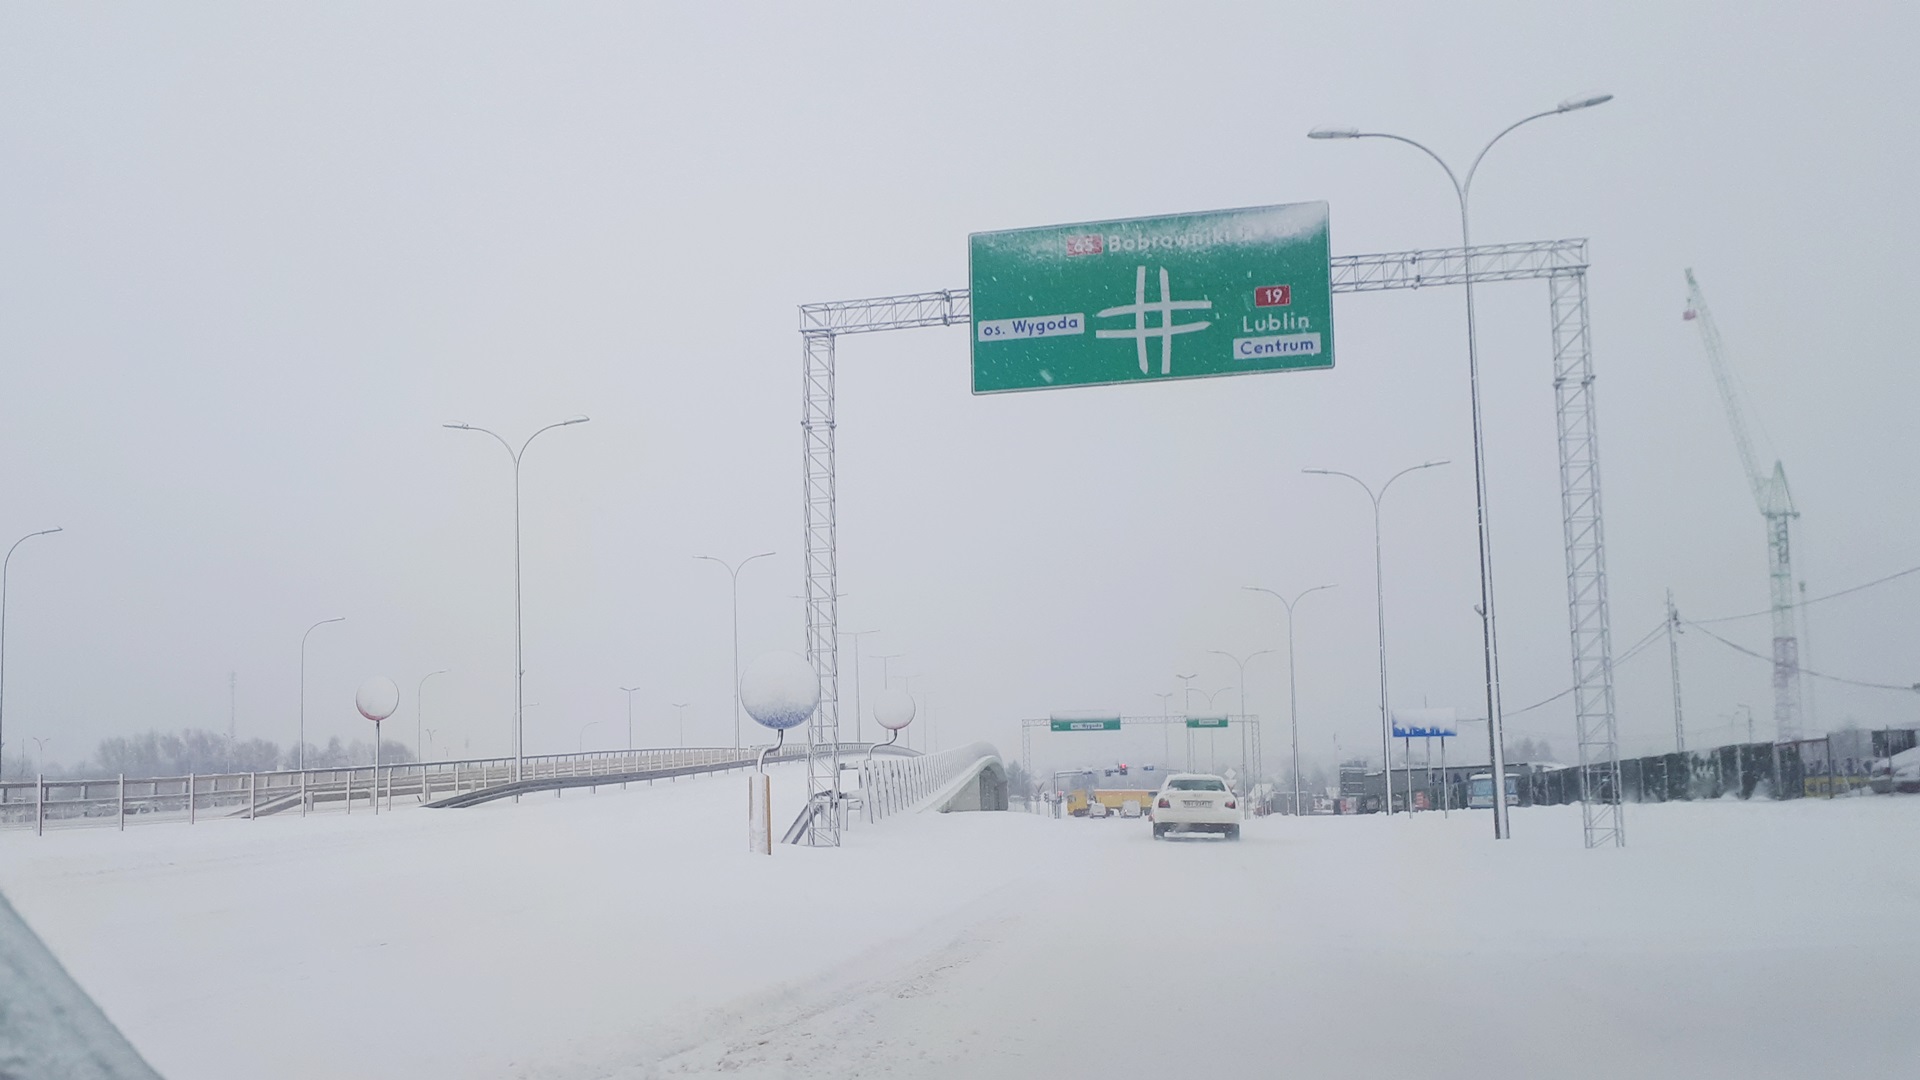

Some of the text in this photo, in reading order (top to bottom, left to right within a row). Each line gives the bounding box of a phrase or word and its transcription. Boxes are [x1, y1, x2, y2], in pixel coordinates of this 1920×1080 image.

[1072, 232, 1231, 253] 65 Bobrowniki
[1265, 288, 1283, 303] 19
[983, 316, 1078, 337] os. Wygoda
[1243, 314, 1310, 333] Lublin
[1240, 338, 1315, 356] Centrum
